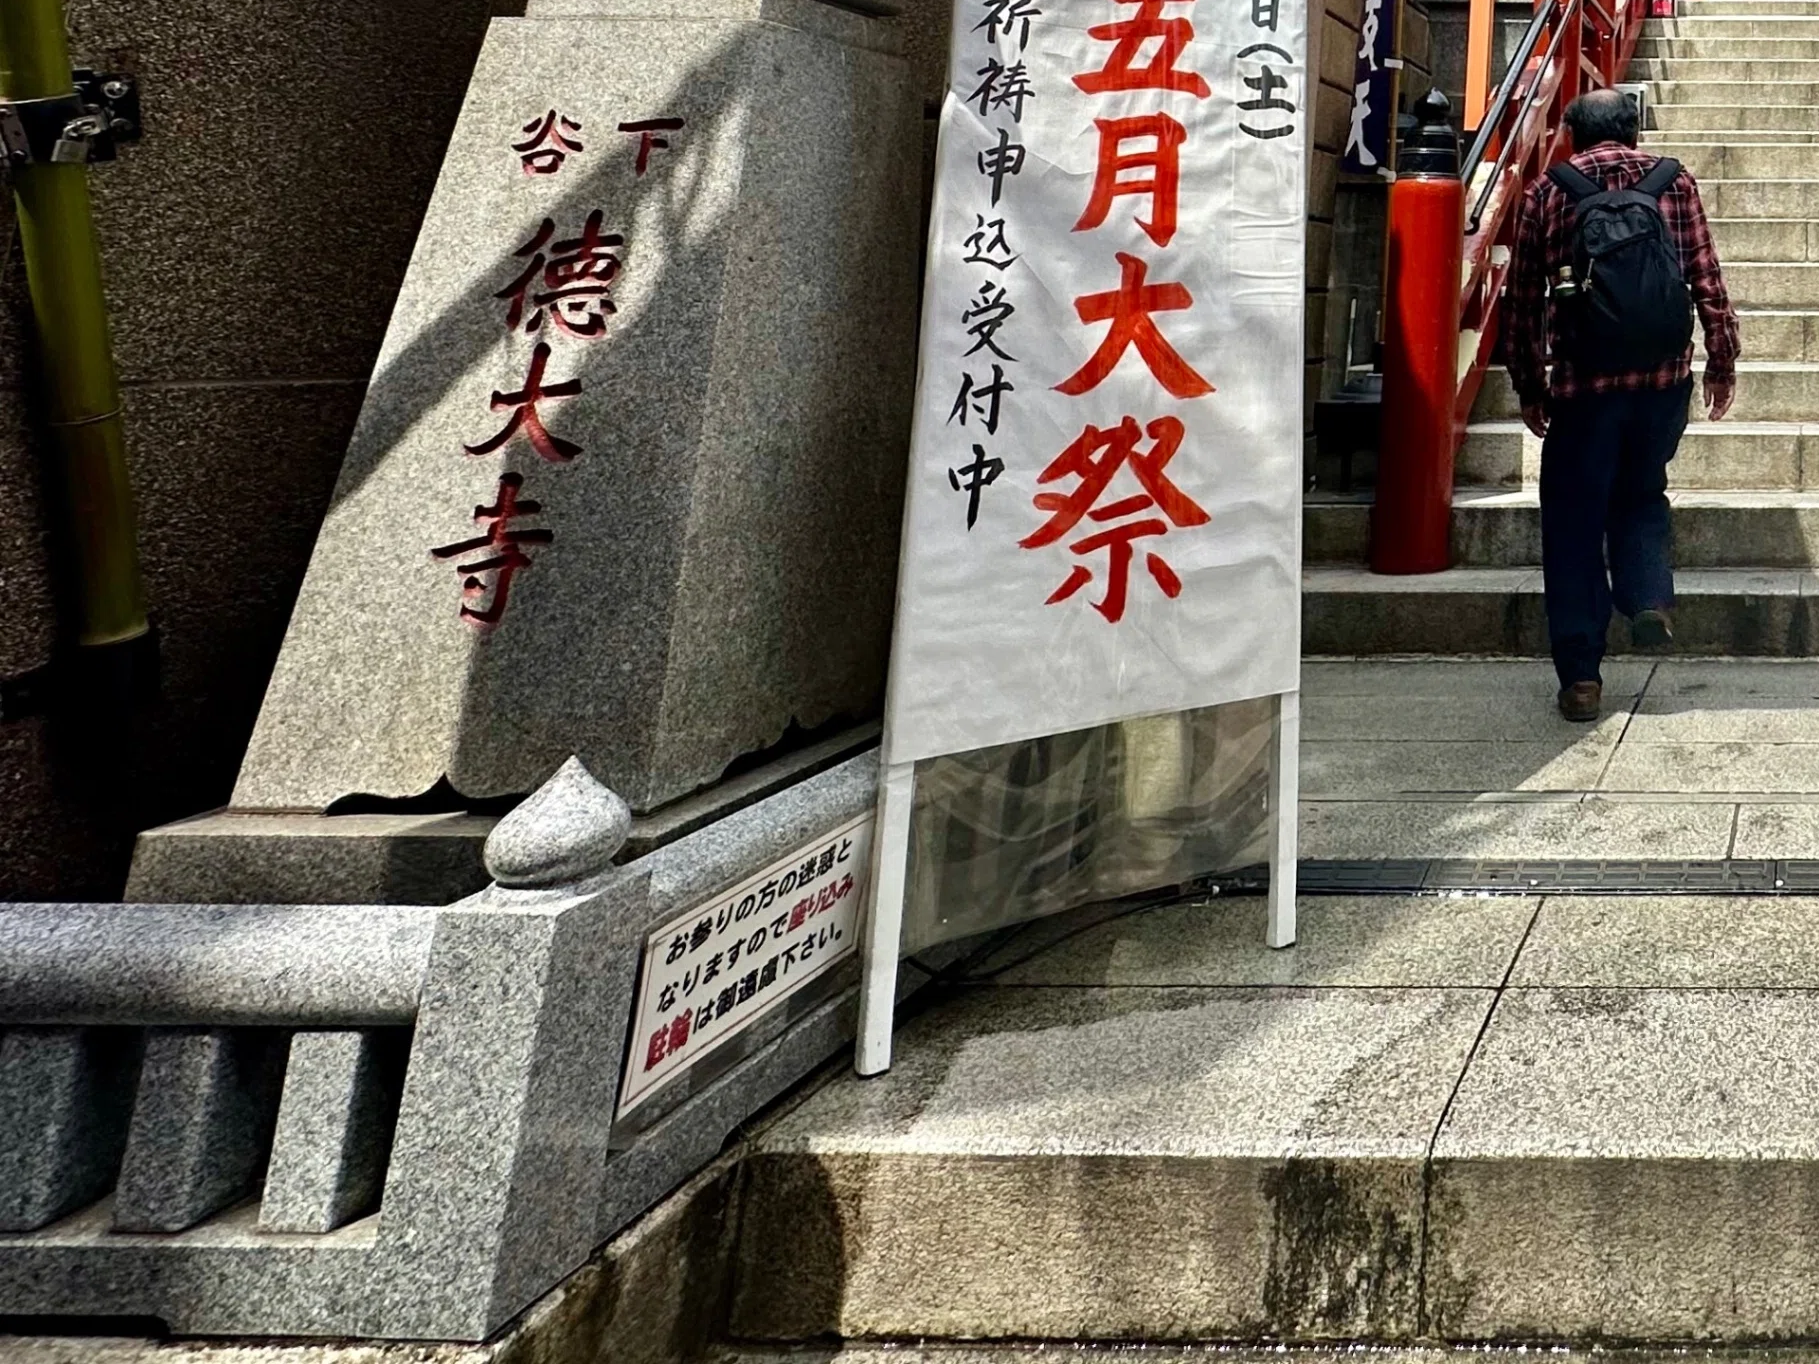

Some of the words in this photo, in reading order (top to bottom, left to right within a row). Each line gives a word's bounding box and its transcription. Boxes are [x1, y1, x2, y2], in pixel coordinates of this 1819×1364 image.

[666, 838, 852, 966] お参りの方の迷惑と
